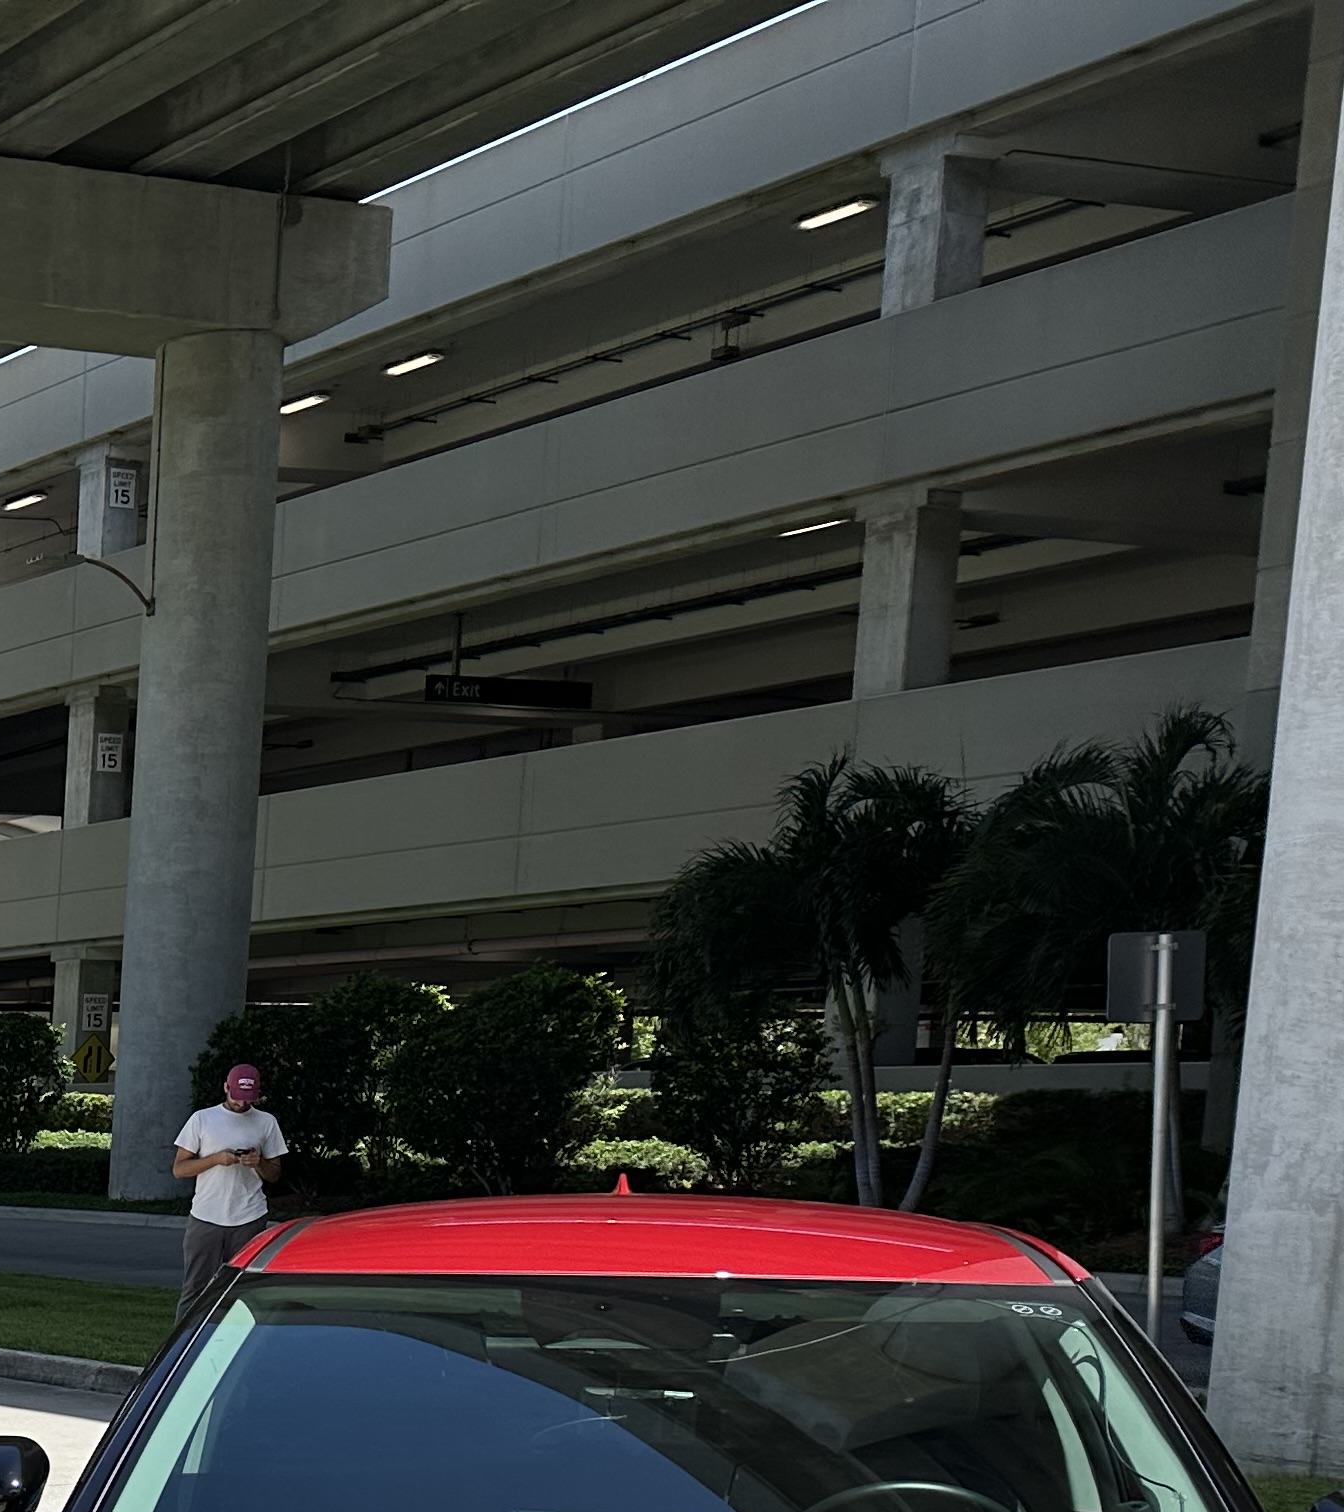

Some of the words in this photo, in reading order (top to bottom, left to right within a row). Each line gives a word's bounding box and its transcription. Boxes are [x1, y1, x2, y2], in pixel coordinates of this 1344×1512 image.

[114, 489, 130, 504] 15
[452, 682, 480, 697] Exit
[102, 753, 117, 769] 15
[87, 1013, 103, 1027] 15
